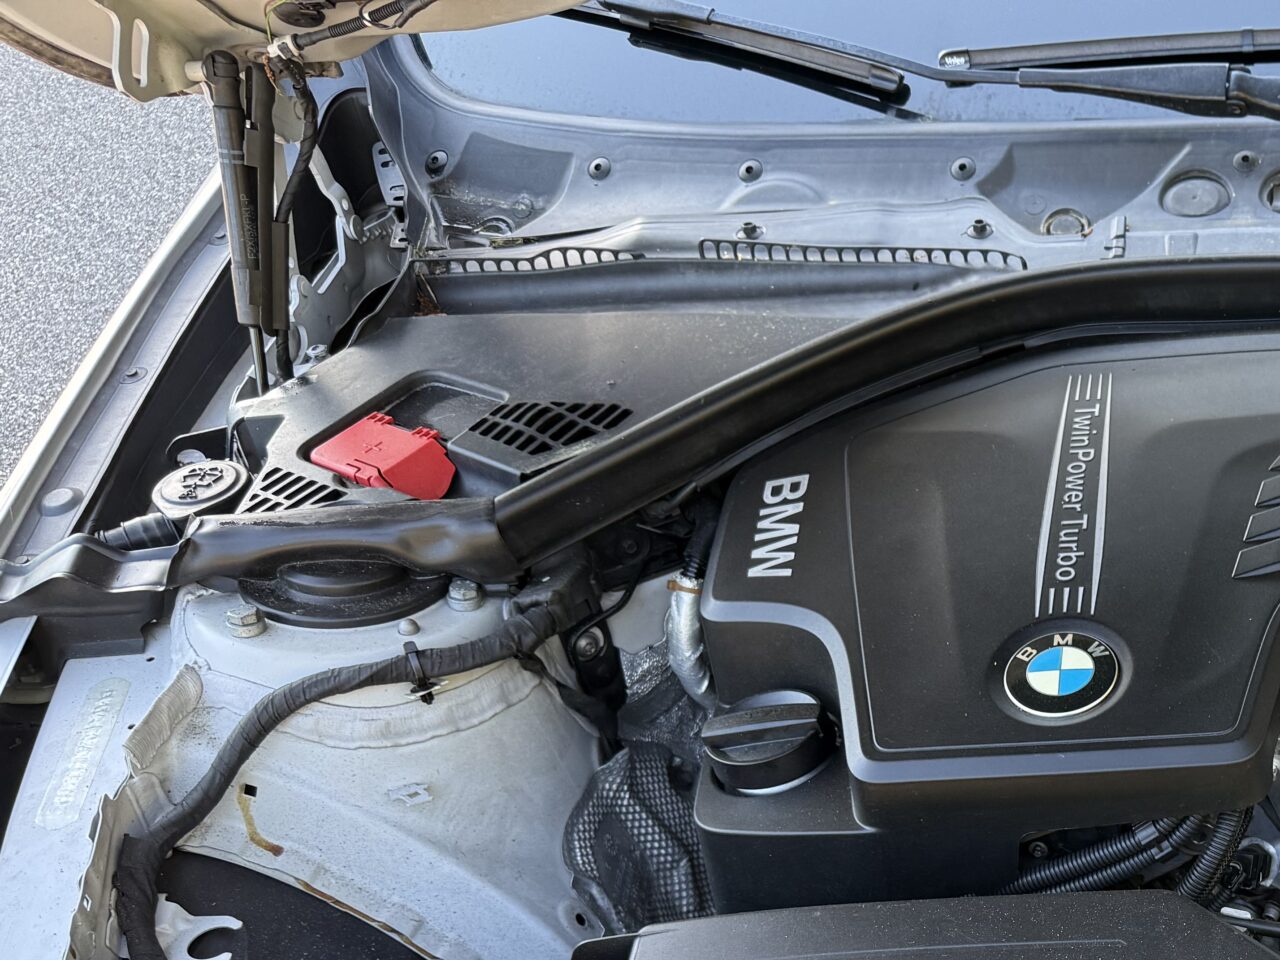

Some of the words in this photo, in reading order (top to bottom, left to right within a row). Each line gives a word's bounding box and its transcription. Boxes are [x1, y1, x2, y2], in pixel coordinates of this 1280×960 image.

[1062, 404, 1100, 511] TwinPower
[747, 474, 810, 577] BMW
[1055, 514, 1088, 581] Turbo
[1015, 633, 1110, 662] BMW
